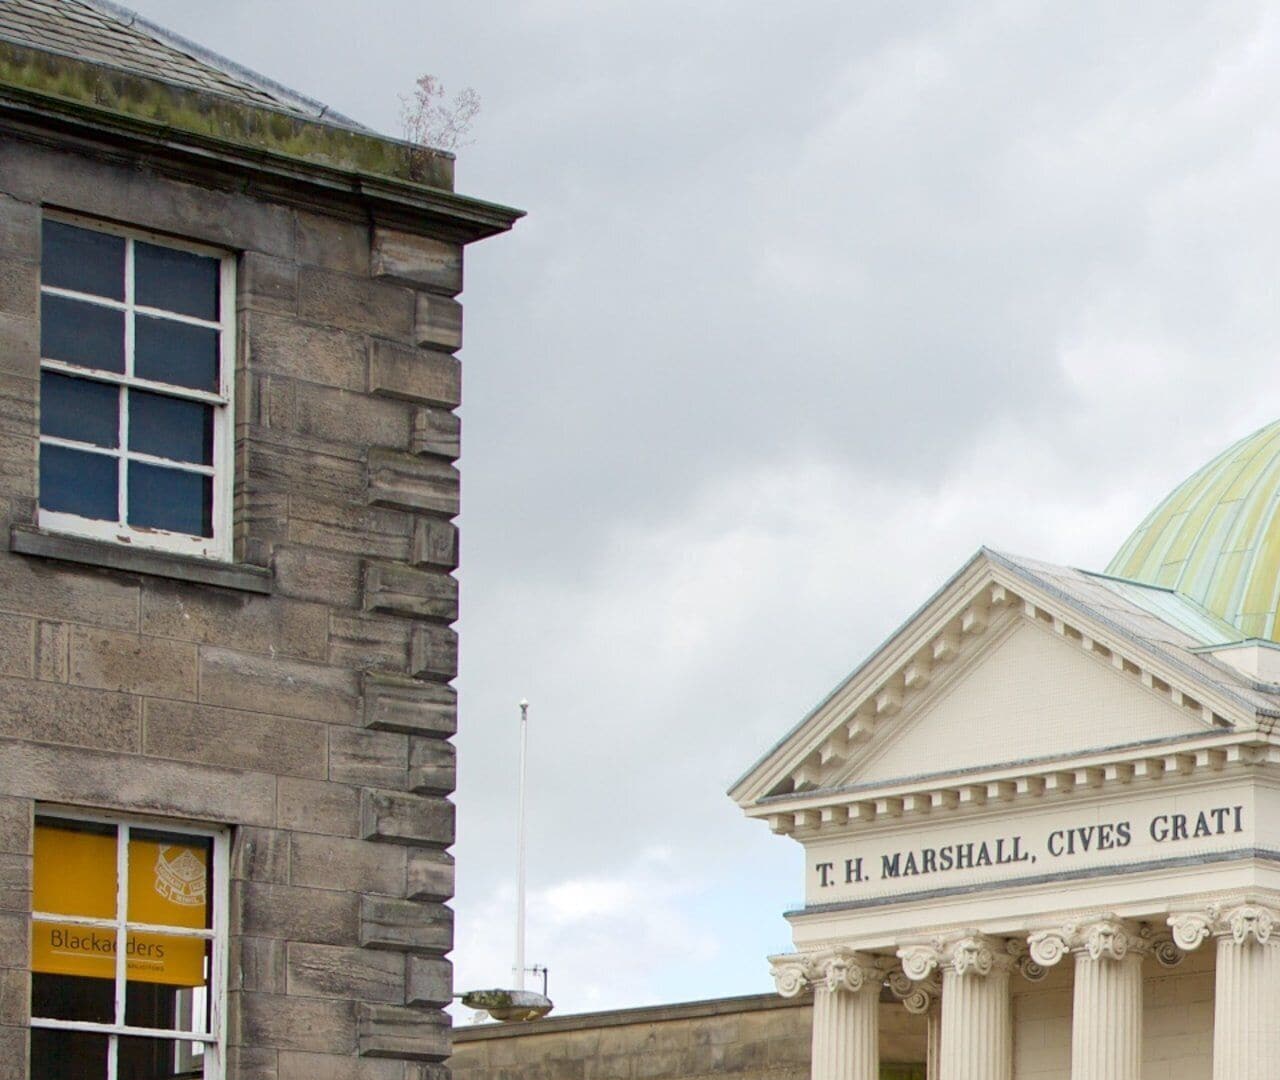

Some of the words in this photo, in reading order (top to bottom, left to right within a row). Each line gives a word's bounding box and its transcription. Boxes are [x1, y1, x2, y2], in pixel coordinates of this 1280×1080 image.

[816, 862, 834, 888] T.
[845, 857, 869, 884] H.
[880, 836, 1037, 880] MARSHALL,
[1046, 821, 1131, 857] CIVES
[1149, 806, 1244, 843] GRATI
